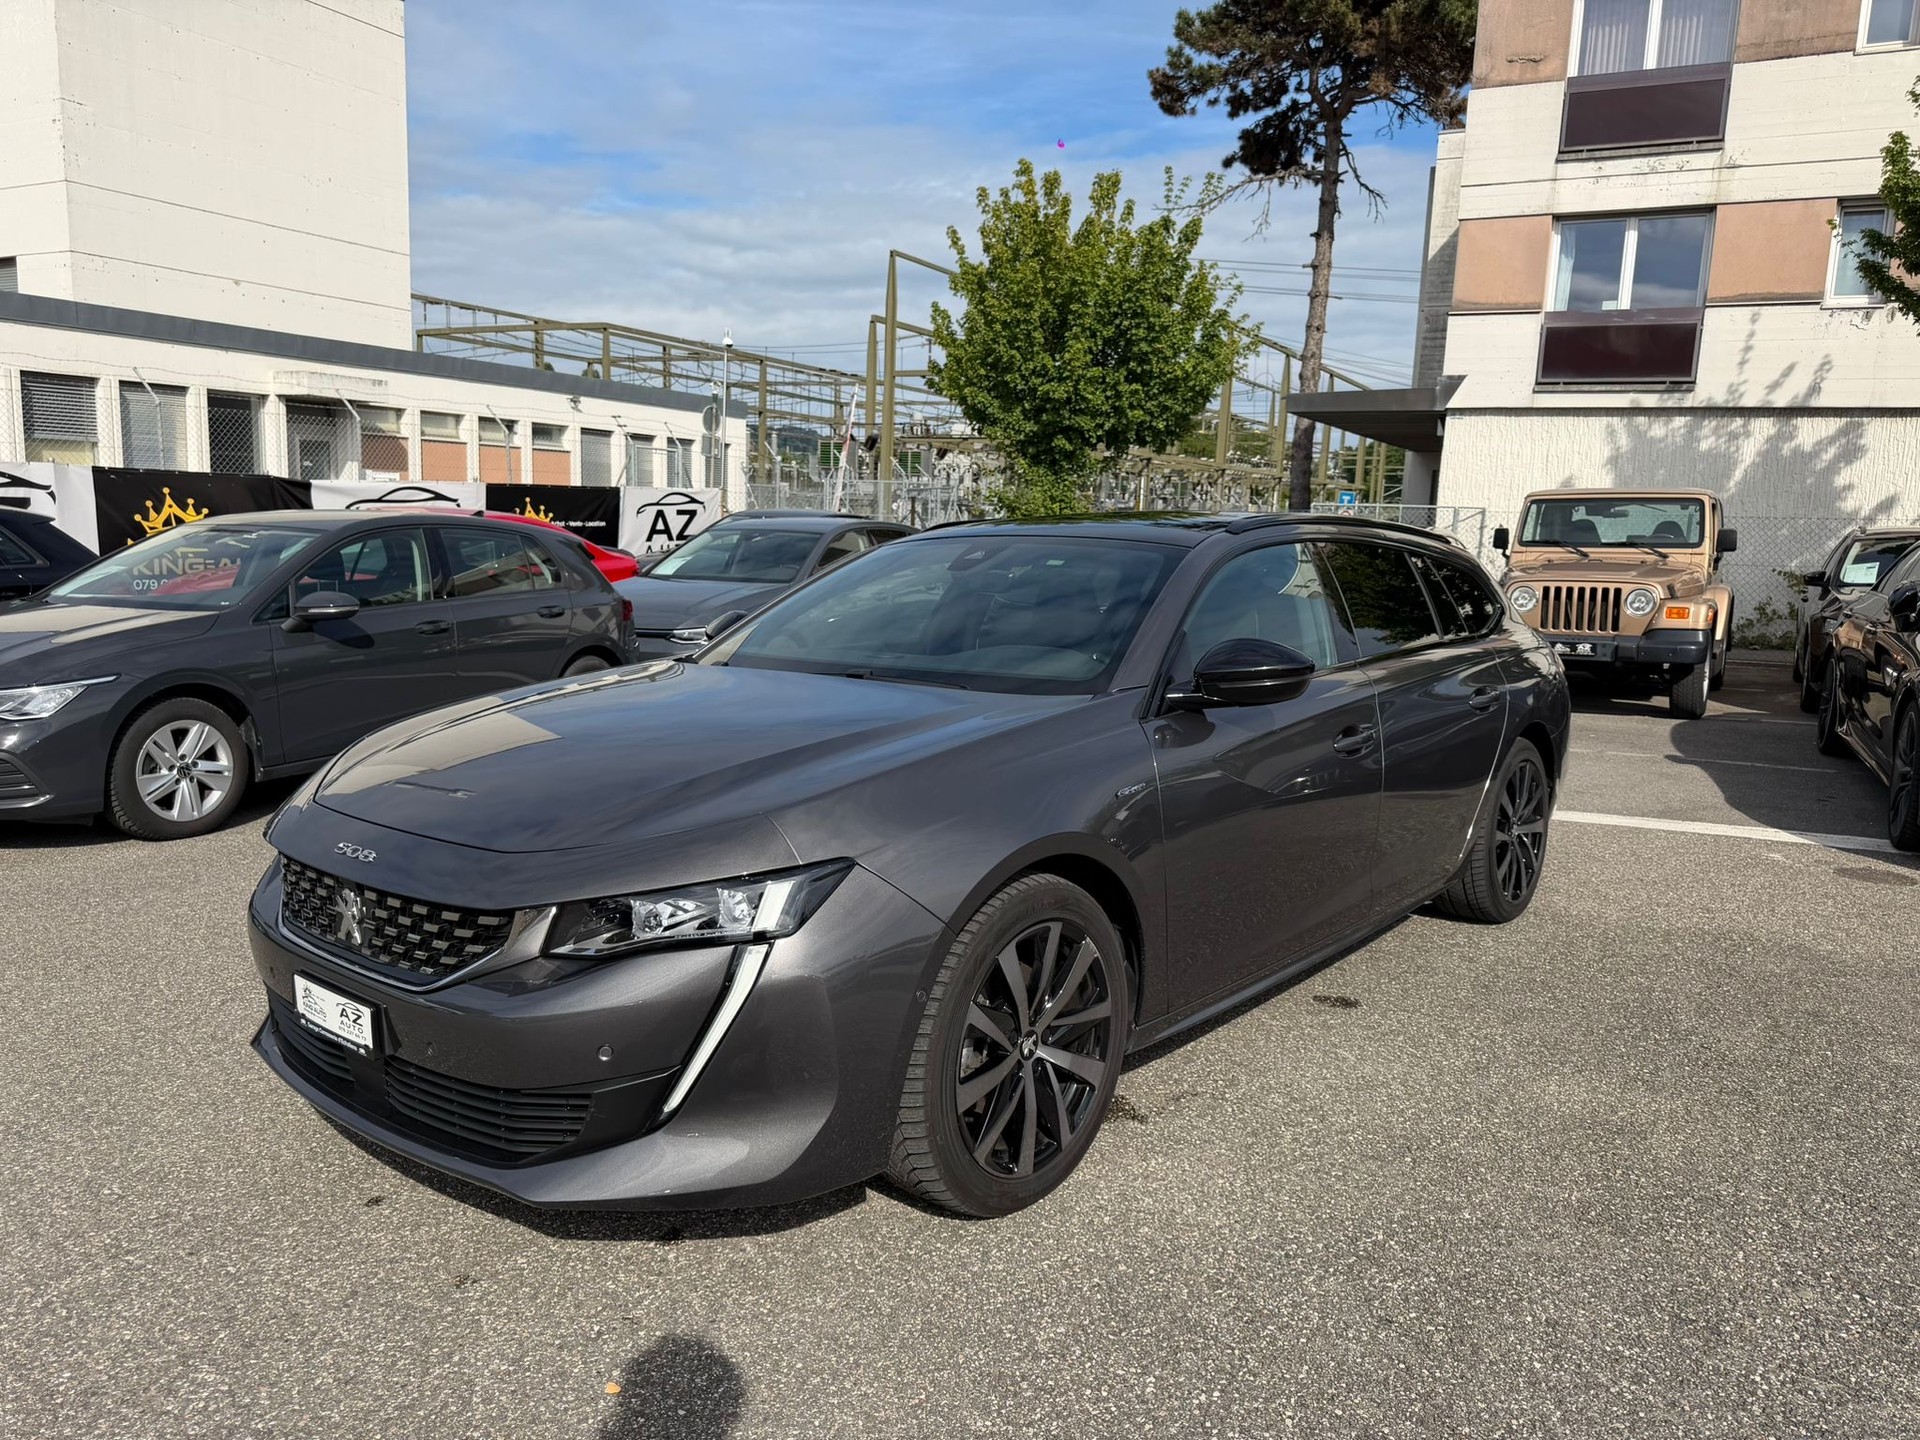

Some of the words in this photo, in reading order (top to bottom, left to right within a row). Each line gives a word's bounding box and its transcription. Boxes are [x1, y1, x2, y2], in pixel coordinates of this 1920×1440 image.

[645, 509, 698, 542] AZ
[133, 579, 158, 590] 079
[334, 842, 377, 861] 508
[340, 1007, 363, 1027] AZ
[340, 1020, 363, 1035] AUTO
